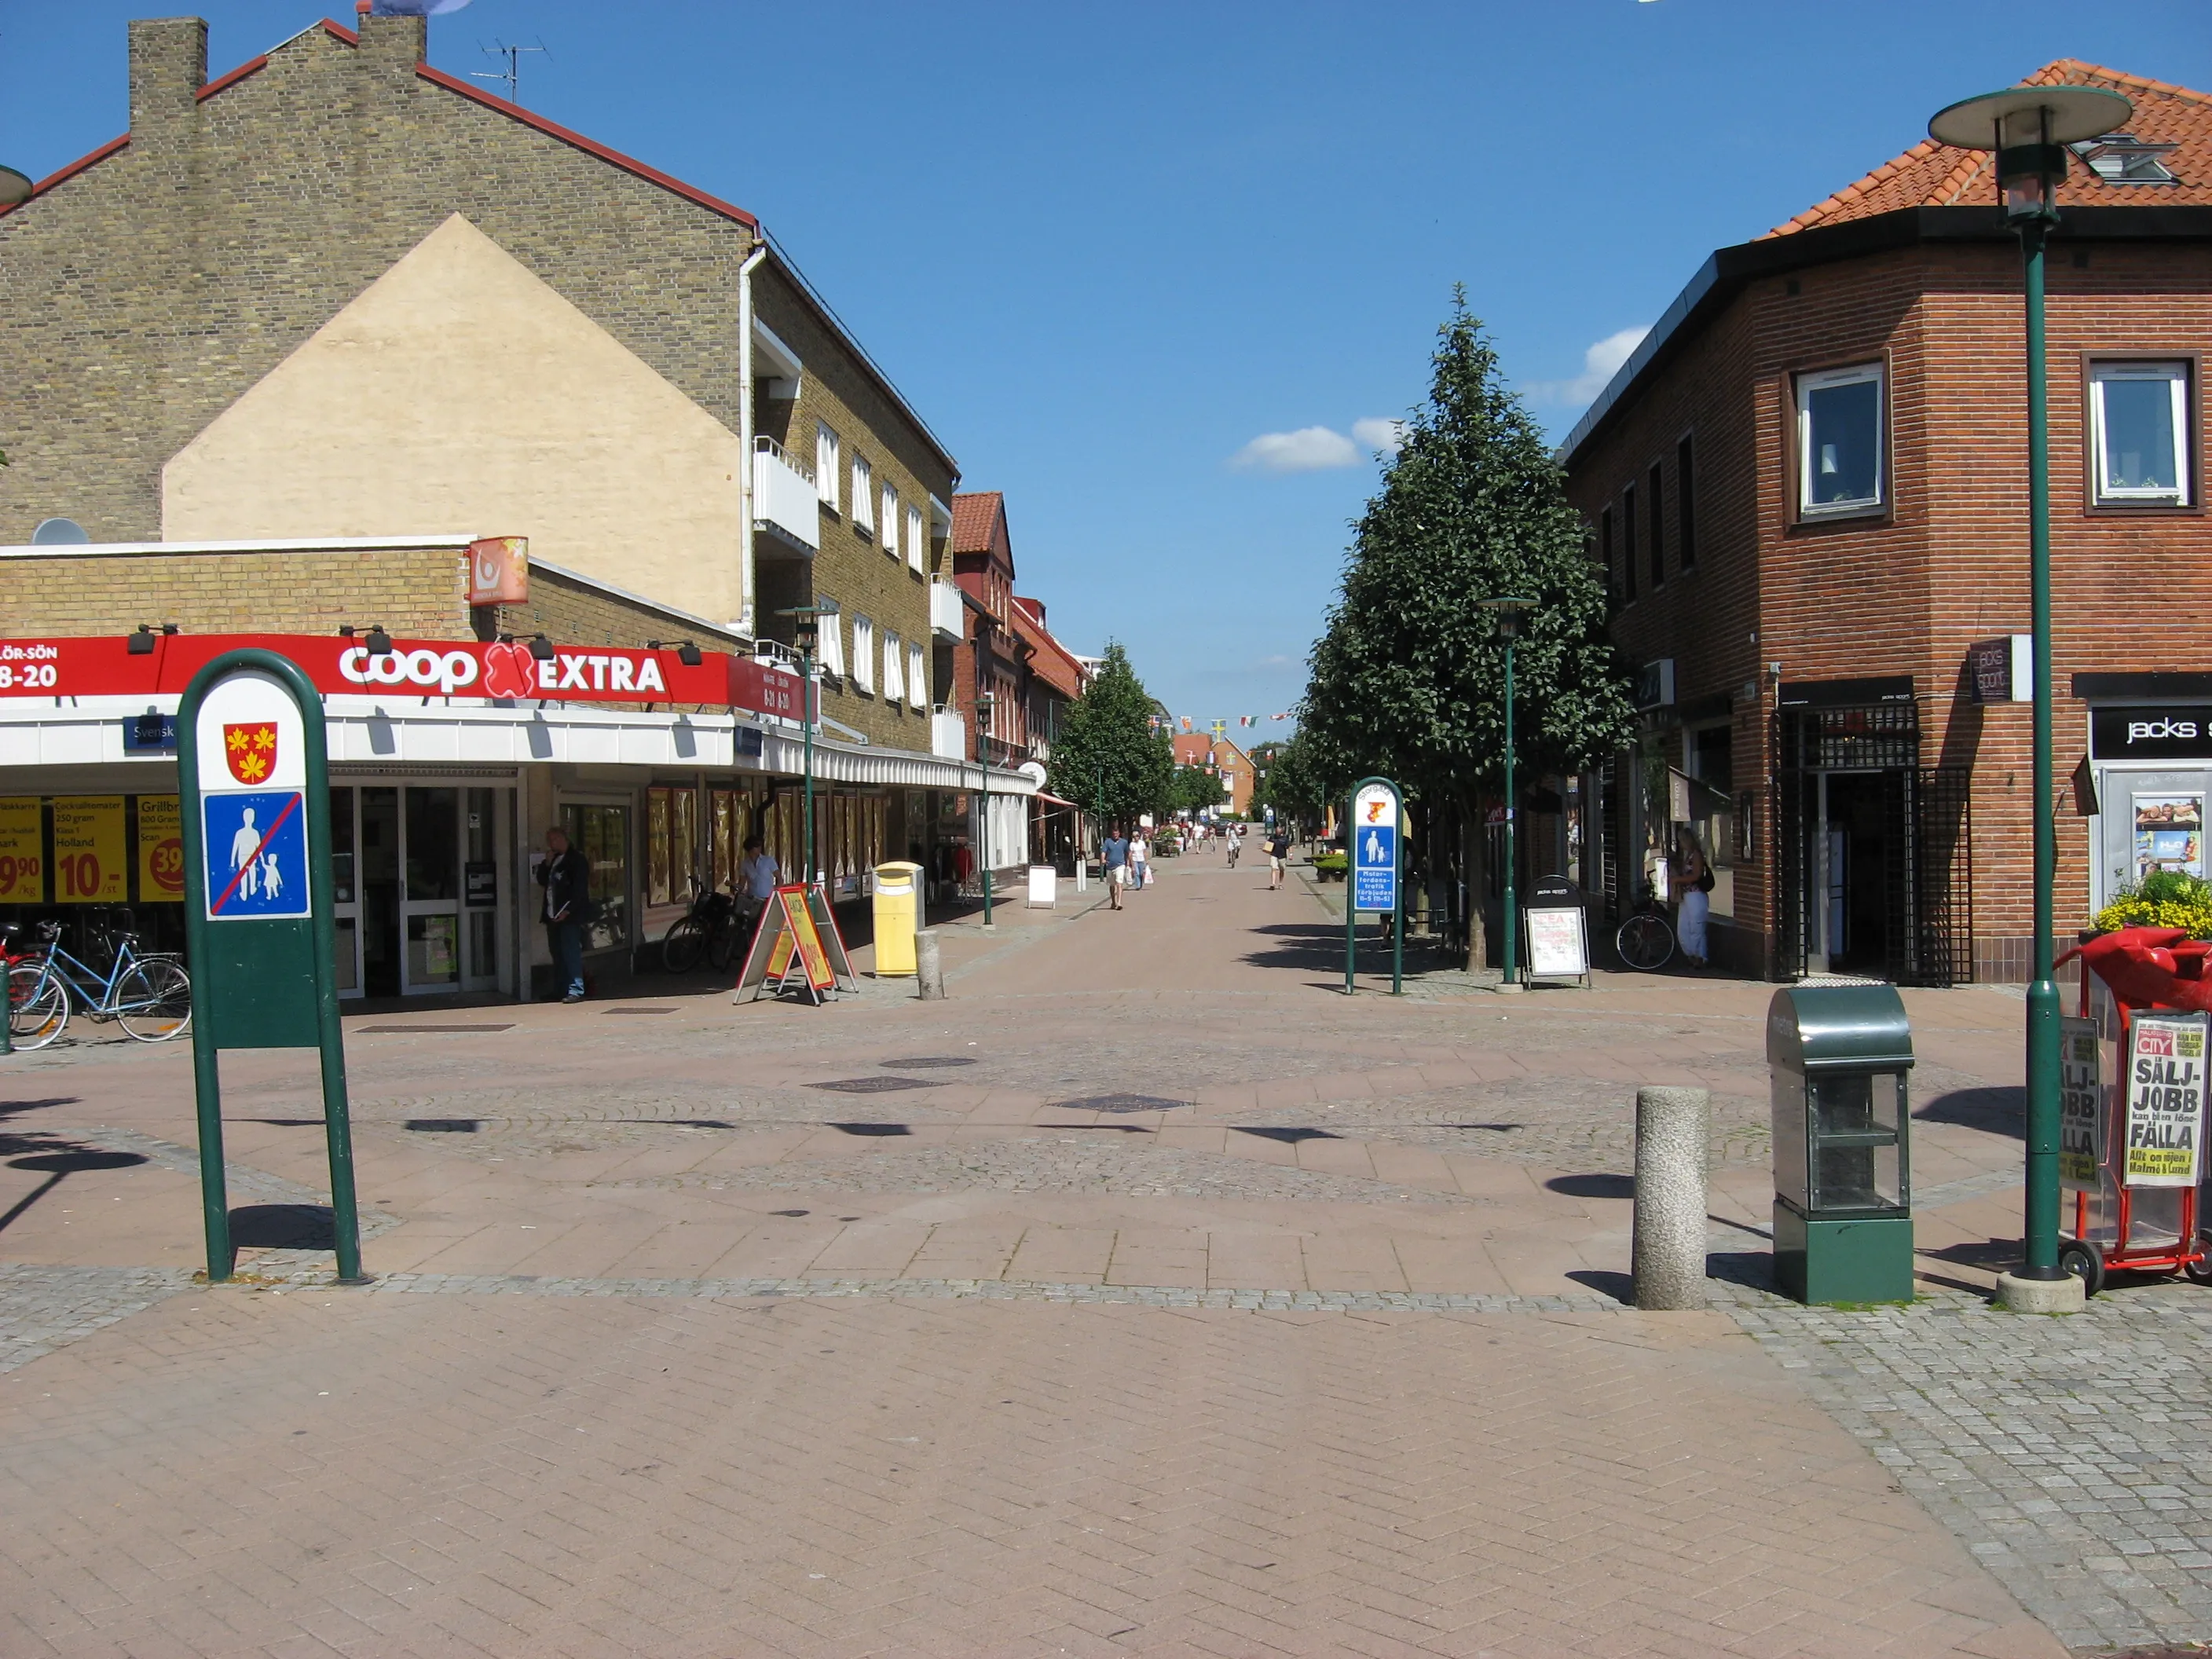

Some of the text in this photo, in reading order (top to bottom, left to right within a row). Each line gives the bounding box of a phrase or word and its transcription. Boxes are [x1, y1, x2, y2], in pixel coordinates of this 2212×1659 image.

[0, 644, 57, 660] ÖR-SÖN
[0, 665, 57, 688] 8-20
[538, 654, 665, 692] EXTRA
[134, 726, 174, 738] Svensk
[2126, 716, 2197, 745] jacks
[56, 814, 95, 824] 250 gram
[56, 837, 95, 848] Holland
[2138, 1037, 2171, 1053] CITY
[2135, 1057, 2200, 1086] SÄLJ-
[2133, 1086, 2199, 1112] JOBB
[2130, 1121, 2193, 1150] FÄLLA
[2130, 1150, 2147, 1162] Allt
[2130, 1162, 2161, 1174] Malmö
[2168, 1163, 2191, 1174] Lund
